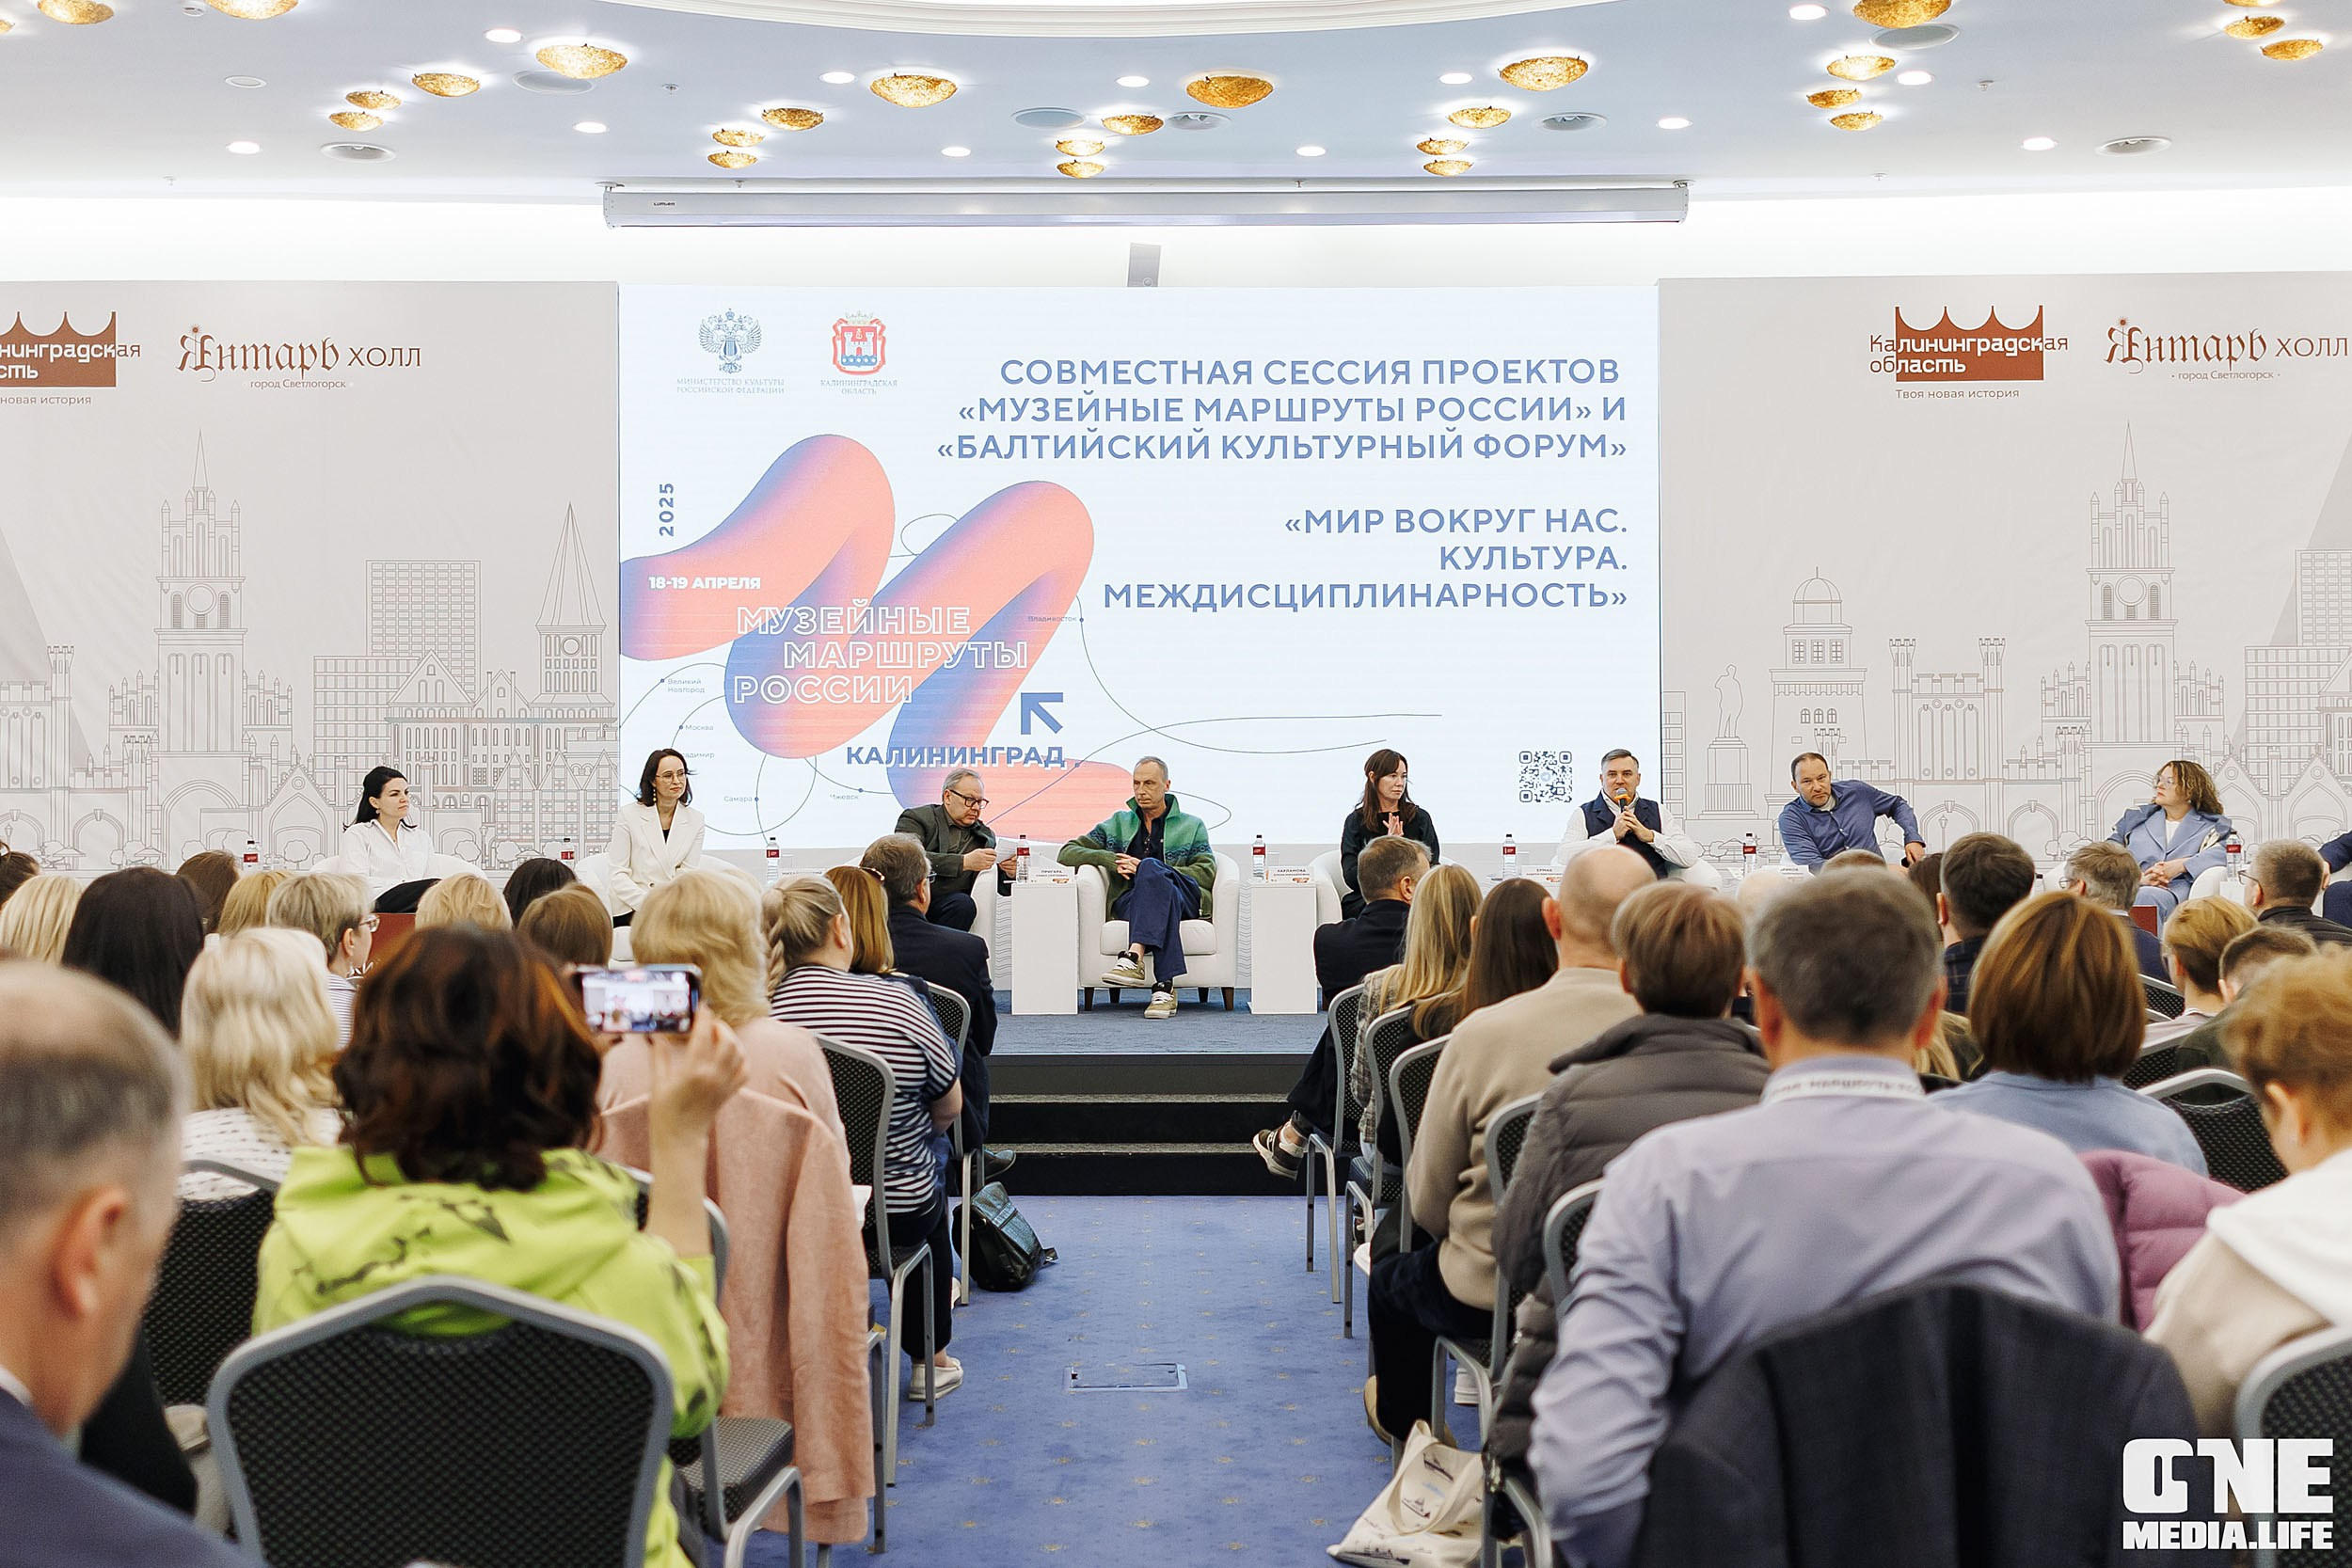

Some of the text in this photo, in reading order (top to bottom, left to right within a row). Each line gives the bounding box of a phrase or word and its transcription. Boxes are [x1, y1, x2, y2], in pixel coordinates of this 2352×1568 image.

[1869, 334, 2069, 357] Калининградская
[1000, 358, 1619, 386] СОВМЕСТНАЯ СЕССИЯ ПРОЕКТОВ
[1869, 357, 1966, 374] область
[2178, 368, 2275, 382] город Светлогорск
[250, 378, 346, 390] город Светлогорск
[676, 386, 785, 395] РОССИЙСКОЙ ФЕДЕРАЦИИ
[820, 379, 898, 388] КАЛИНИНГРАДСКАЯ
[1896, 388, 2020, 400] Твоя новая история
[40, 396, 91, 406] история
[958, 390, 1626, 422] «МУЗЕЙНЫЕ МАРШРУТЫ РОССИИ» И
[937, 428, 1627, 461] «БАЛТИЙСКИЙ КУЛЬТУРНЫЙ ФОРУМ»
[659, 482, 675, 537] 2025
[1284, 509, 1628, 534] «МИР ВОКРУГ НАС.
[1439, 546, 1628, 571] КУЛЬТУРА.
[647, 576, 761, 590] 18-19 АПРЕЛЯ
[1104, 582, 1628, 613] МЕЖДИСЦИПЛИНАРНОСТЬ»
[737, 598, 971, 635] МУЗЕЙНЫЕ
[784, 641, 1027, 669] МАРШРУТЫ
[667, 676, 702, 685] Великий
[667, 686, 706, 694] Новгород
[734, 675, 913, 704] РОССИИ
[846, 746, 1068, 769] КАЛИНИНГРАД
[723, 795, 753, 803] Самара
